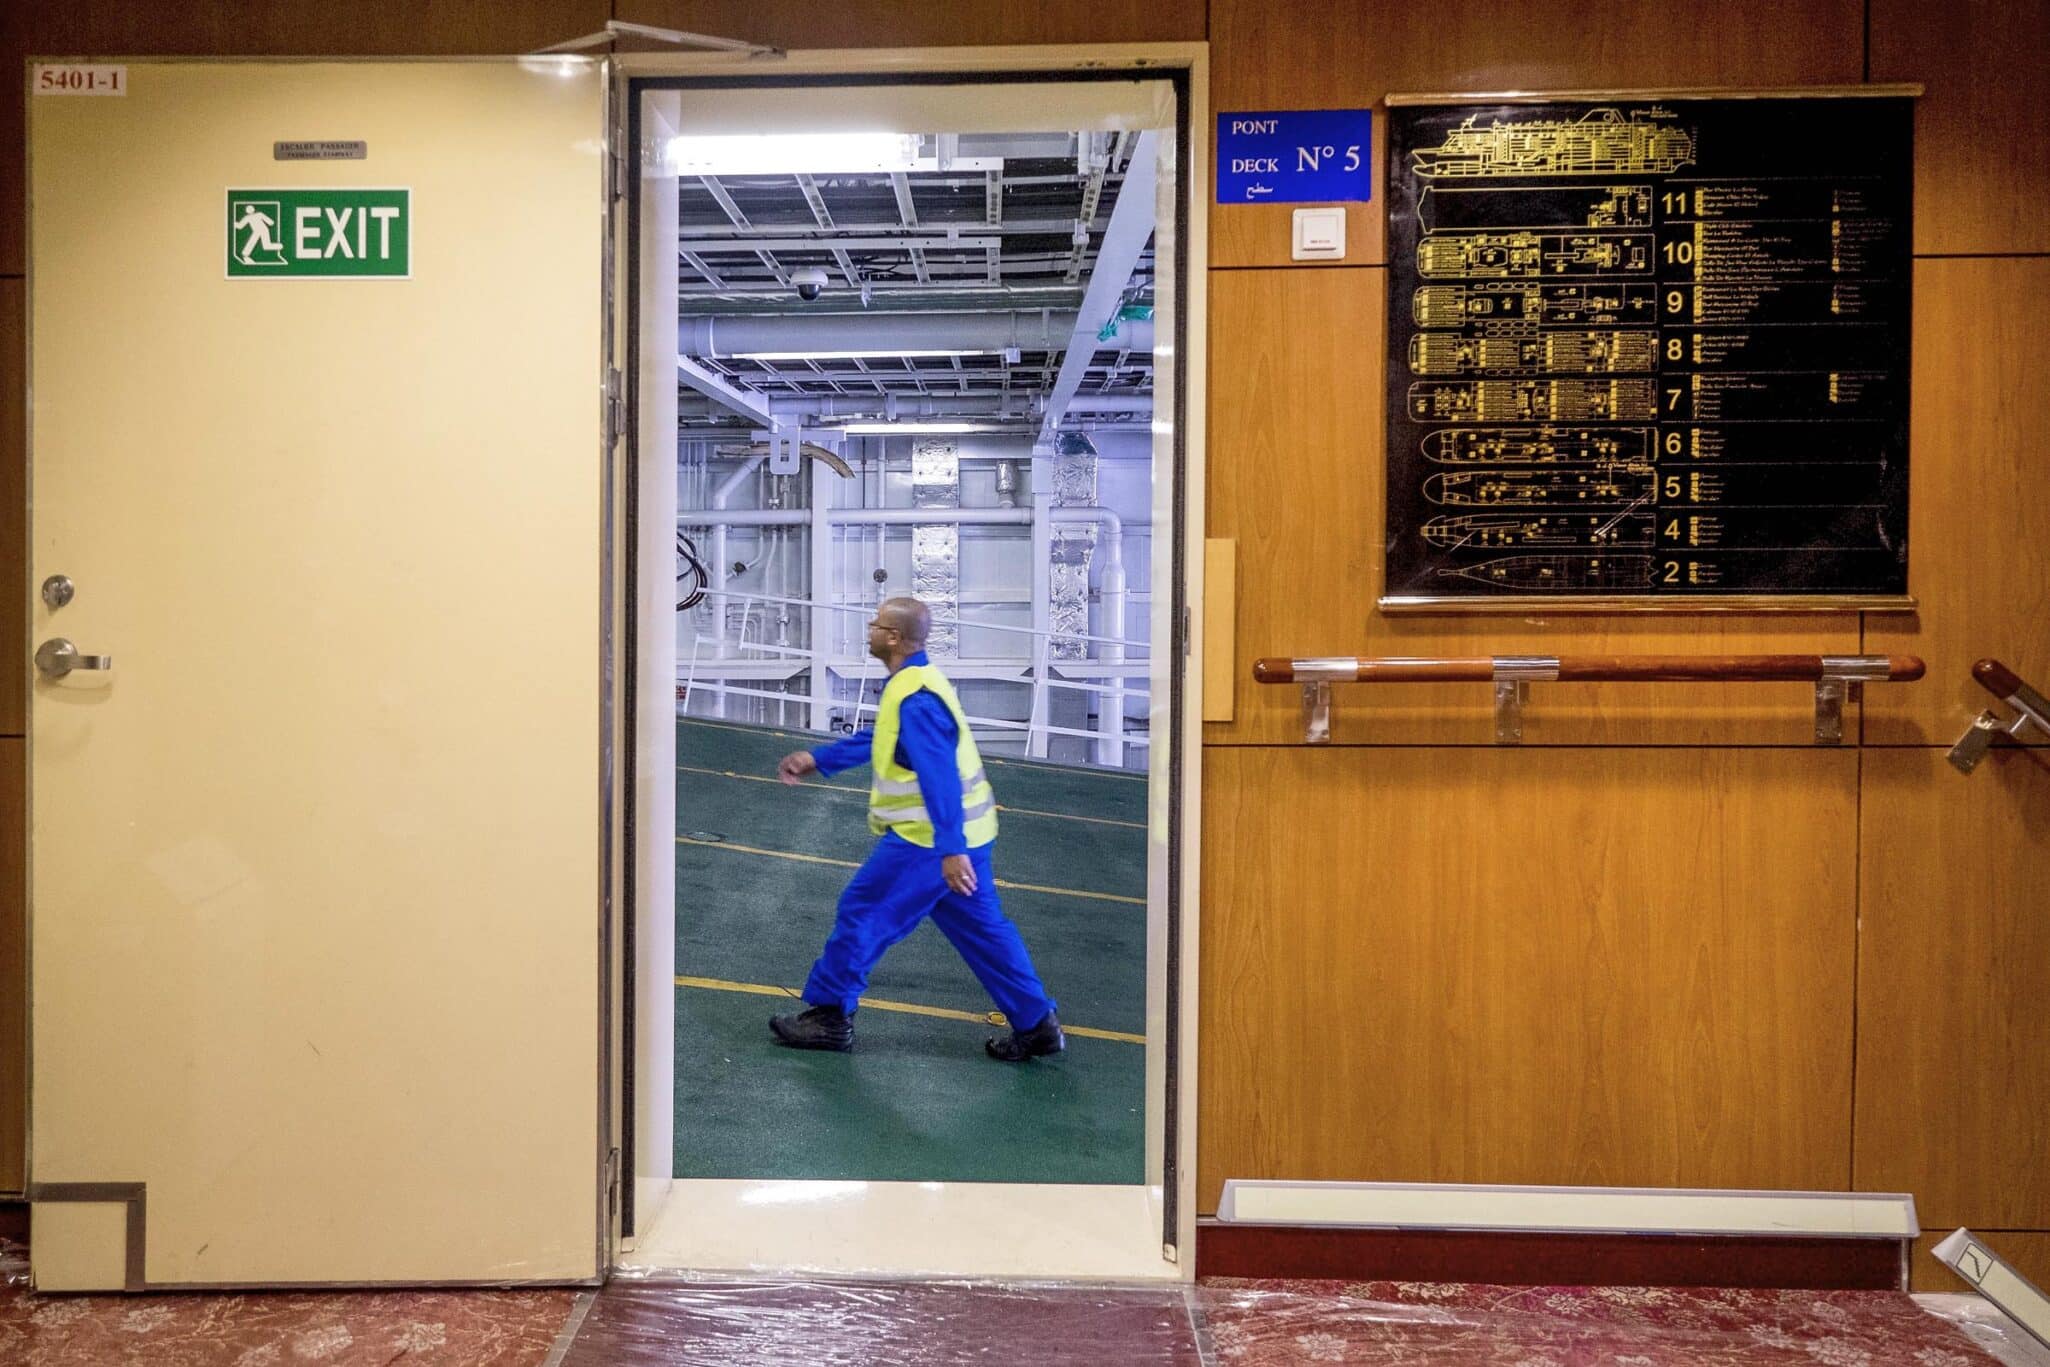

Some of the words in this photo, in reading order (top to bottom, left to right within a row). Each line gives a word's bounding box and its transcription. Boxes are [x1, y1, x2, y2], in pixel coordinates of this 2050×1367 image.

[41, 71, 119, 90] 5401-1
[1233, 121, 1278, 135] PONT
[1233, 158, 1279, 173] DECK
[1344, 145, 1360, 172] 5
[1661, 193, 1686, 215] 11
[295, 206, 400, 260] EXIT
[1664, 242, 1692, 264] 10
[1666, 291, 1683, 313] 9
[1666, 338, 1682, 361] 8
[1666, 388, 1682, 411] 7
[1665, 432, 1681, 454] 6
[1665, 476, 1681, 498] 5
[1664, 519, 1681, 540] 4
[1664, 561, 1680, 583] 2
